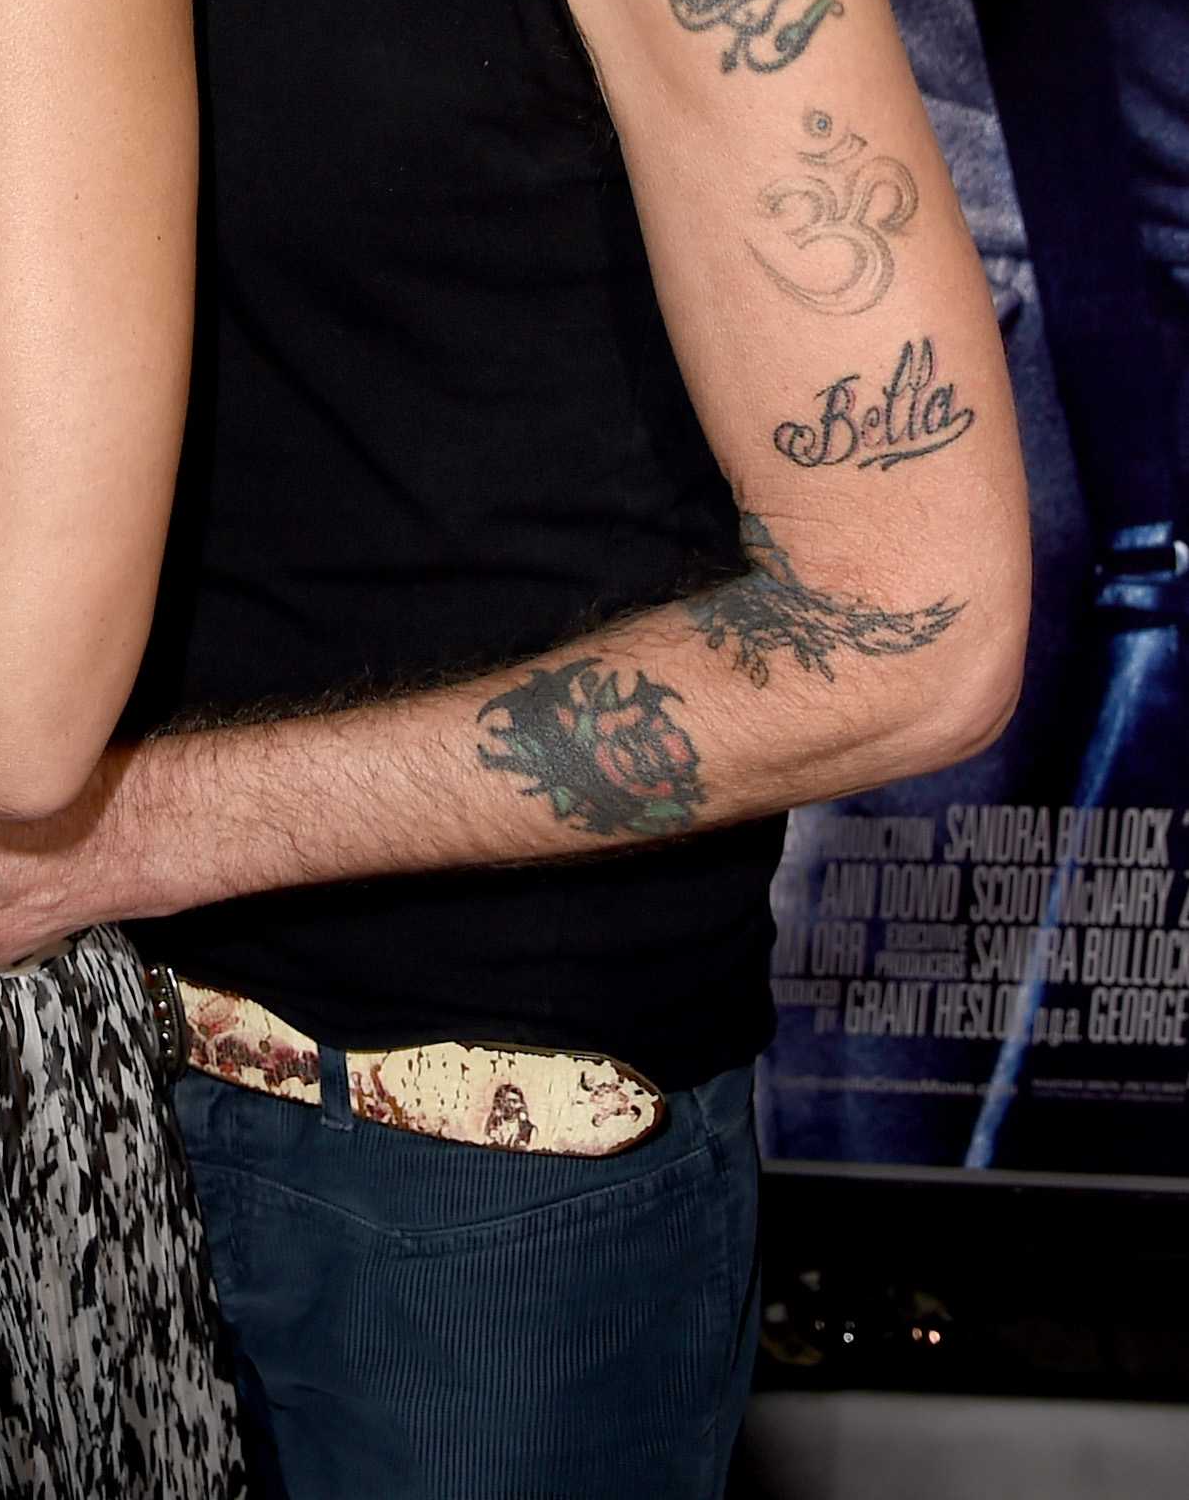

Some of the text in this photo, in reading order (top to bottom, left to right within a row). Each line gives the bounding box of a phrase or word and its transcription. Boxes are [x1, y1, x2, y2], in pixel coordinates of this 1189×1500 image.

[773, 336, 974, 471] Bella
[944, 804, 1051, 863] SANDRA
[1055, 806, 1174, 866] BULLOCK
[819, 862, 878, 919] ANN
[879, 864, 961, 921] DOWD
[969, 865, 1054, 924] SCOOT
[811, 921, 867, 978] ORR
[844, 980, 933, 1037] GRANT
[1087, 987, 1189, 1047] GEORGE
